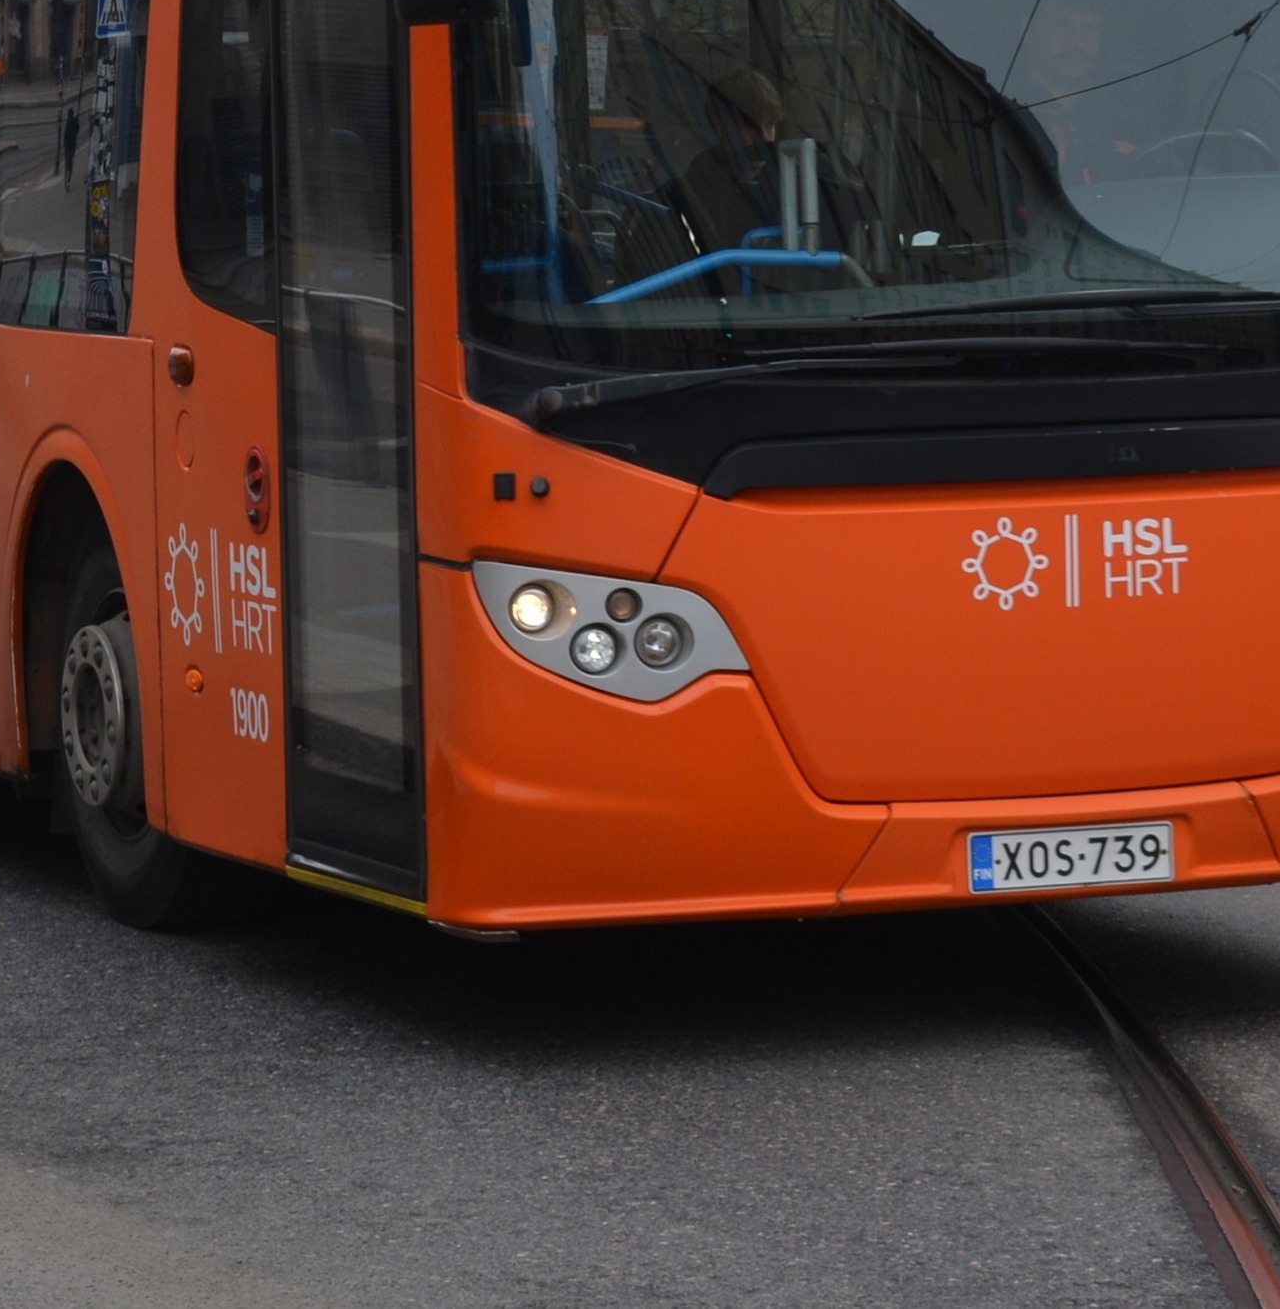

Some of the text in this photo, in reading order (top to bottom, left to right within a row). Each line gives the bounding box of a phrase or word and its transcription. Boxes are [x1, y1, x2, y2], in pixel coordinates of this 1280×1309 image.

[1102, 517, 1189, 557] HSL
[229, 541, 276, 598] HSL
[1104, 557, 1189, 599] HRT
[231, 597, 277, 655] HRT
[230, 687, 268, 743] 1900
[973, 833, 1161, 881] FIN XOS-739
